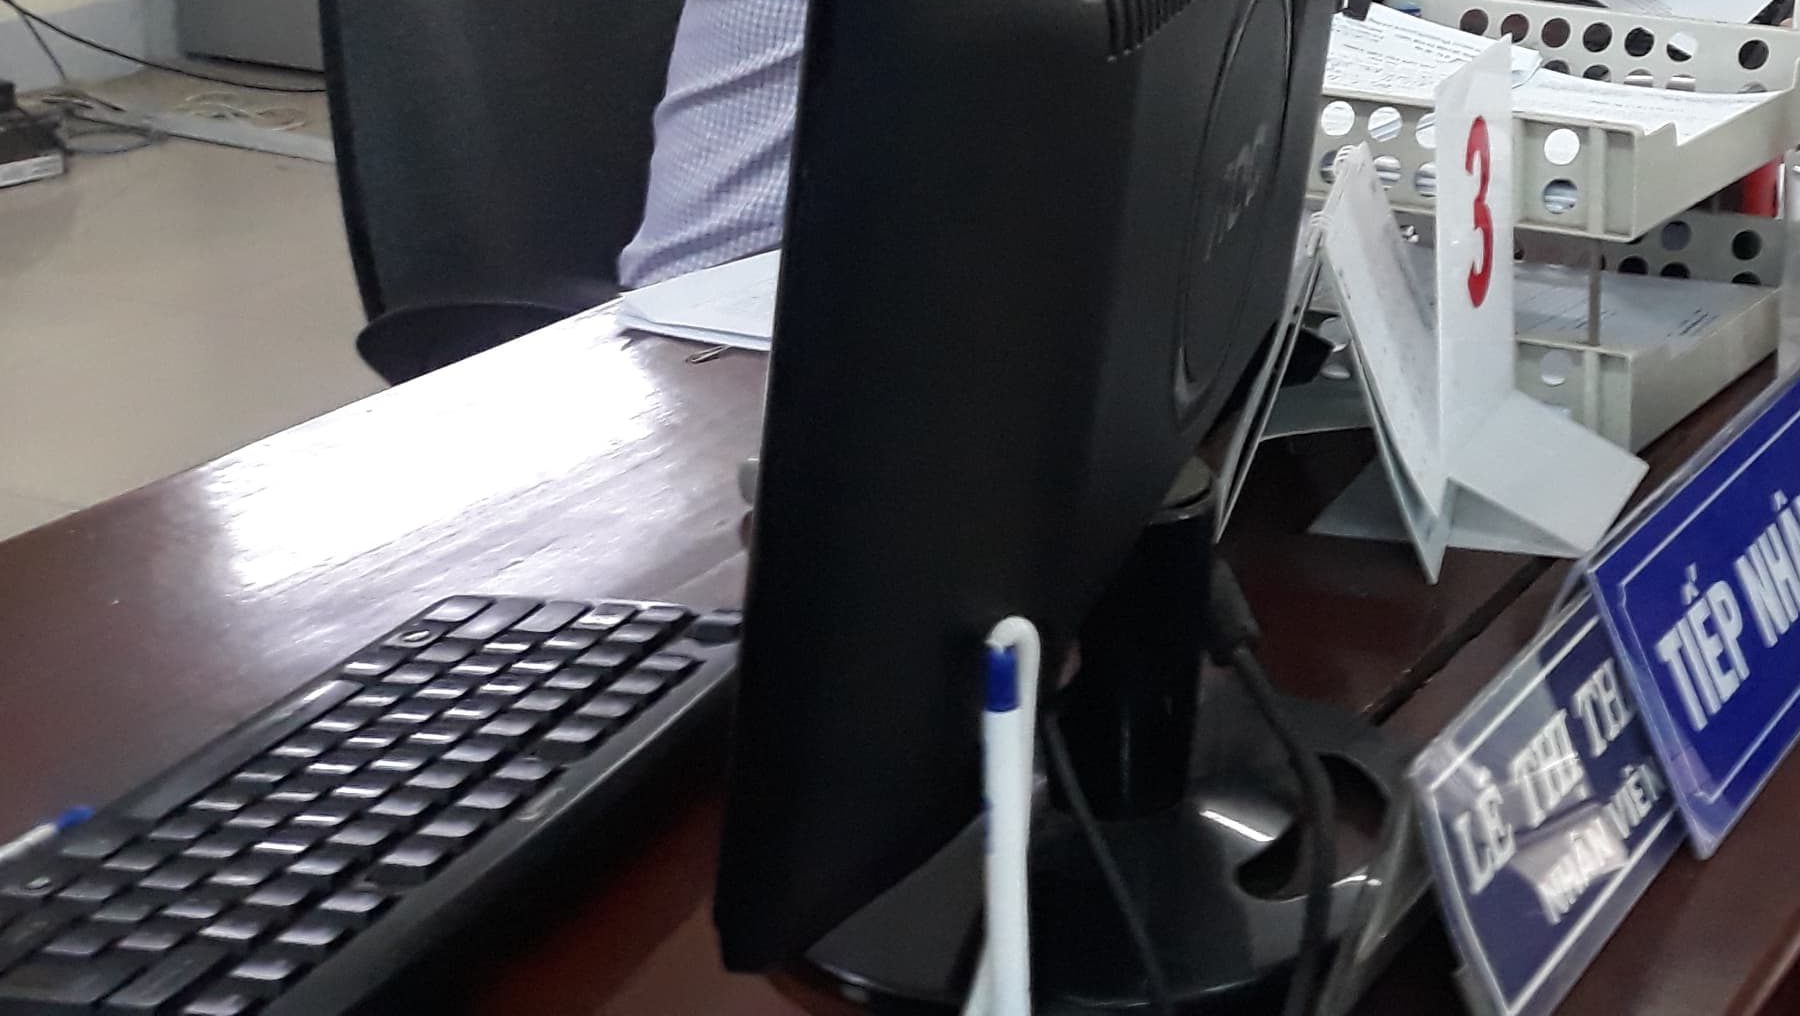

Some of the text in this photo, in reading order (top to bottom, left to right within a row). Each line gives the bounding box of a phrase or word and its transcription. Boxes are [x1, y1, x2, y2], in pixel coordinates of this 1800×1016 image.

[1465, 115, 1494, 308] 3
[1655, 563, 1750, 732] TIẾP
[1454, 766, 1517, 895] LÊ
[1511, 708, 1590, 828] THỊ
